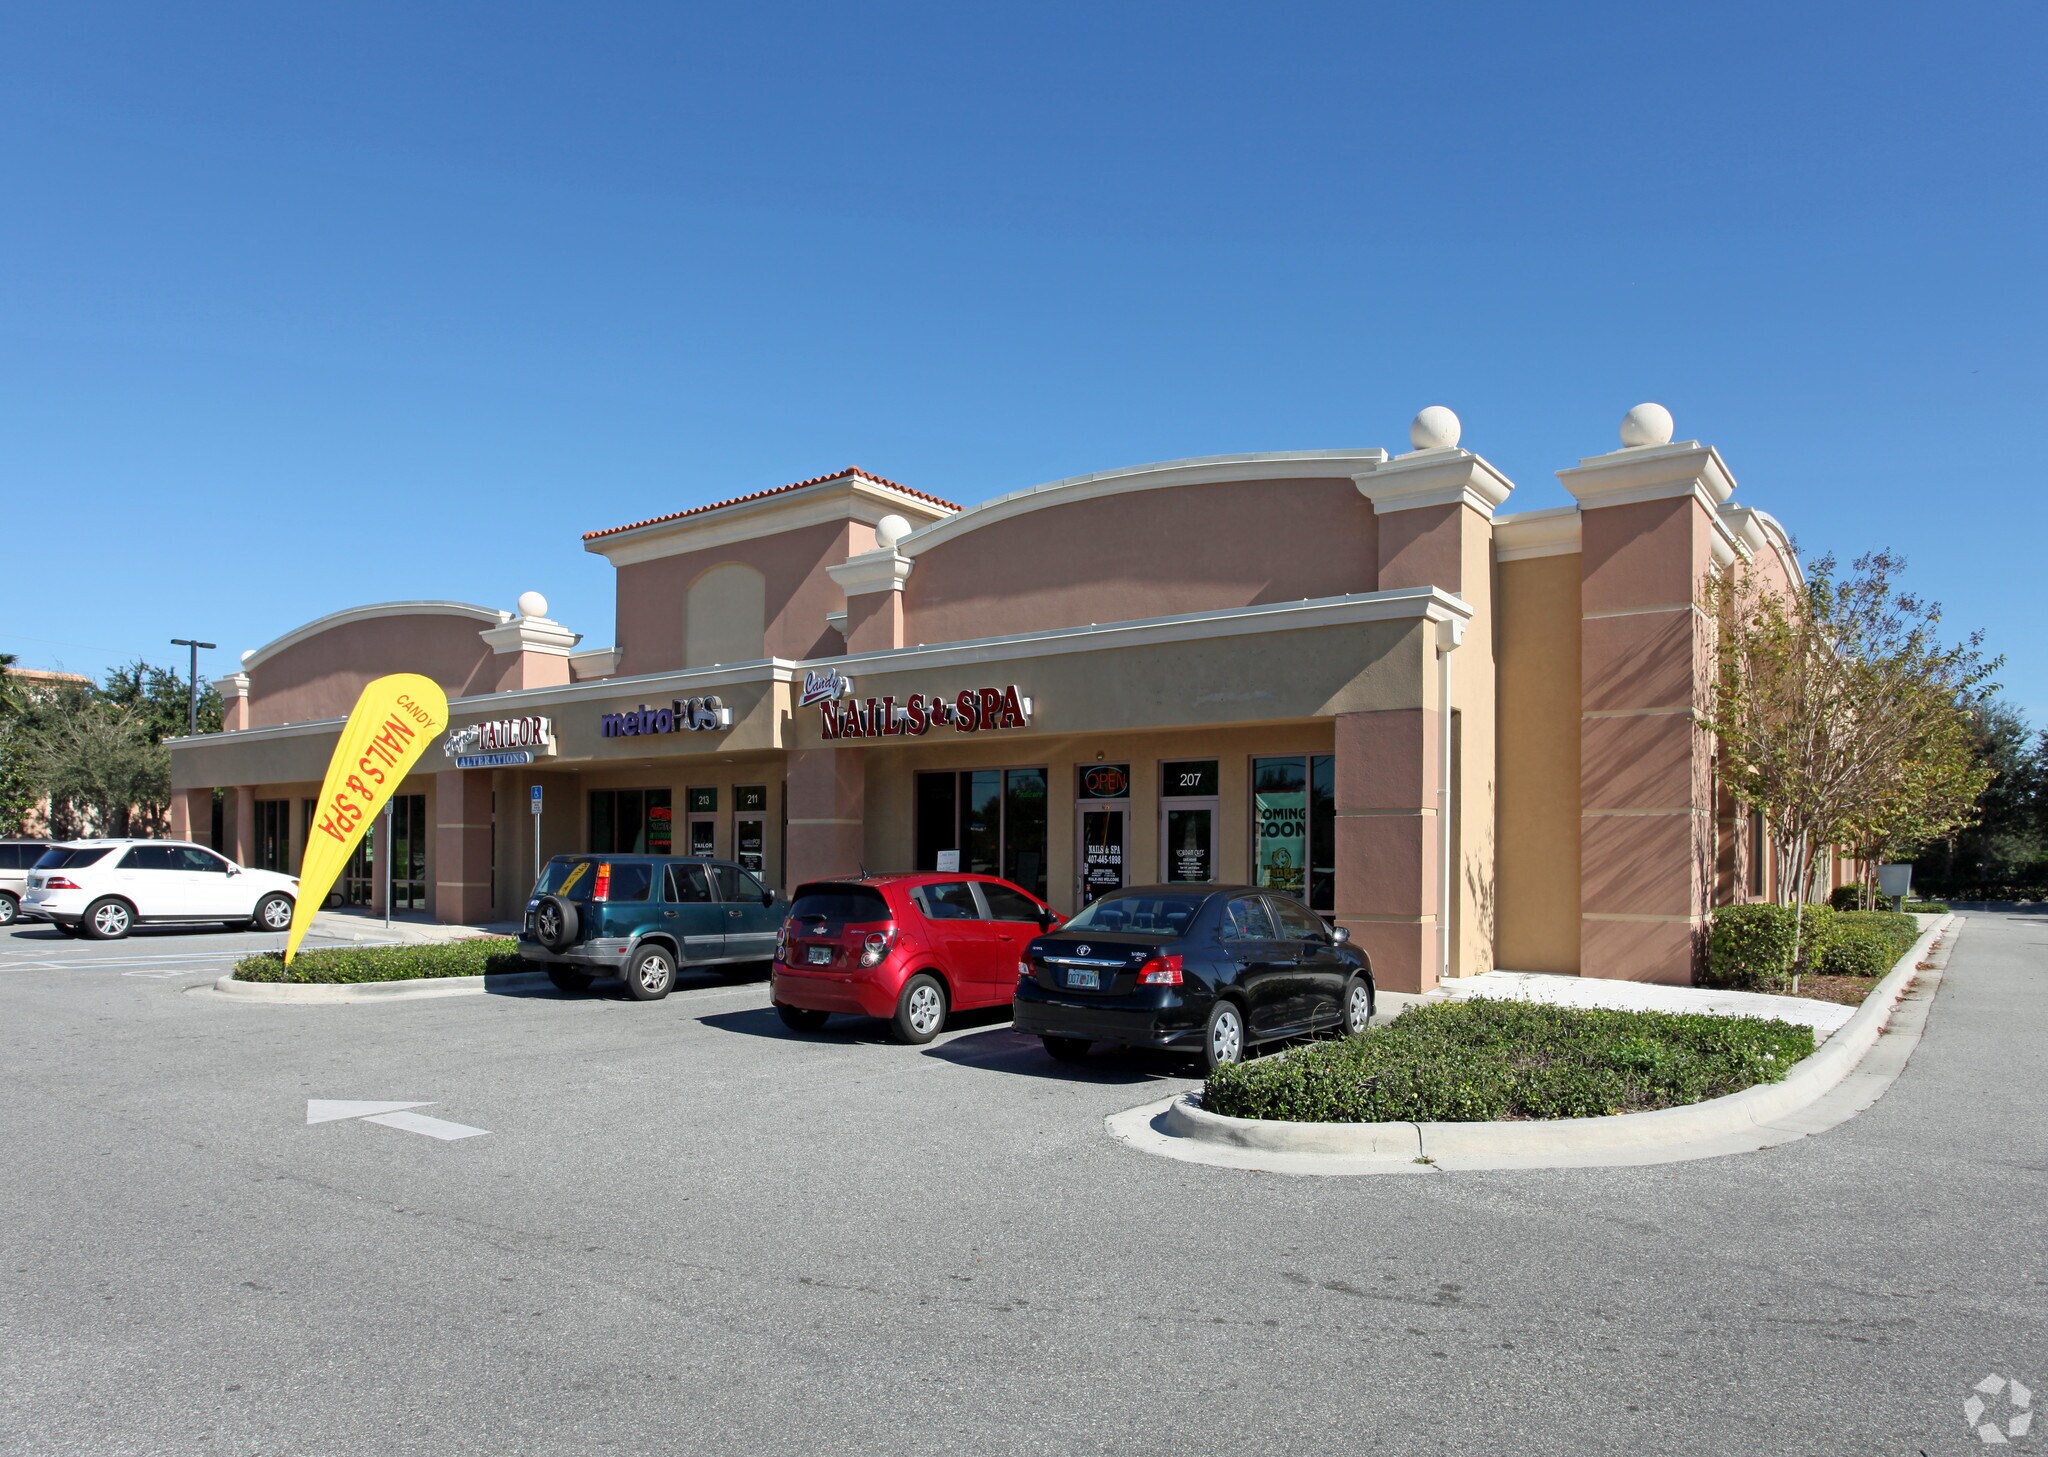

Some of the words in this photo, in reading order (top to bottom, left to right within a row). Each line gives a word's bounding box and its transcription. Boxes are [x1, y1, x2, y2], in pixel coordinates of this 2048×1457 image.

[804, 670, 841, 695] Candy
[397, 694, 436, 729] CANDY
[601, 695, 721, 737] metroPCS
[819, 693, 927, 739] NAILS
[930, 697, 948, 727] &
[955, 684, 1027, 733] SPA
[478, 715, 545, 750] TAILOR
[358, 713, 415, 785] NAILS
[460, 751, 526, 767] ALTERATIONS
[345, 774, 374, 802] &
[1085, 773, 1126, 791] OPEN
[1179, 773, 1201, 786] 207
[698, 795, 710, 805] 213
[747, 794, 758, 804] 211
[317, 793, 362, 843] SPA
[1260, 808, 1305, 820] OMING
[1088, 845, 1104, 854] NAILS
[1110, 845, 1121, 855] SPA
